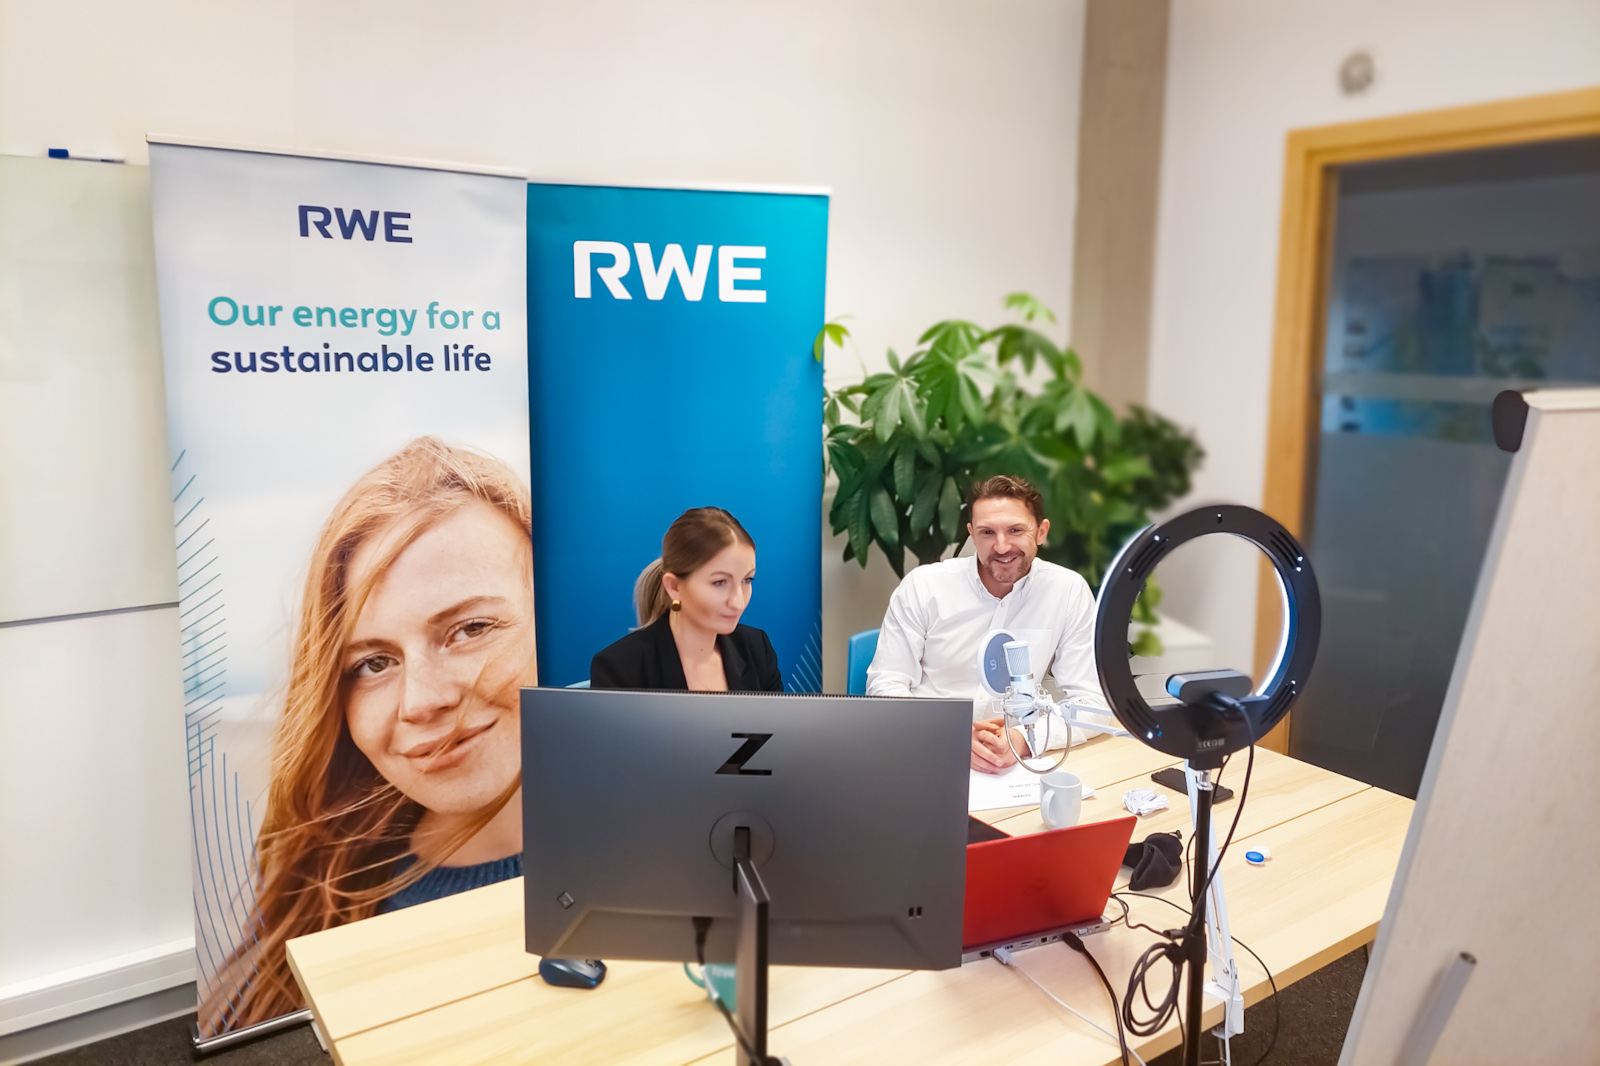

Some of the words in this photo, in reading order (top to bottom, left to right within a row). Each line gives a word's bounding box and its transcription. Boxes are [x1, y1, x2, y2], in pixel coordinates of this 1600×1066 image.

[298, 205, 413, 244] RWE
[573, 240, 767, 303] RWE
[207, 295, 284, 328] Our
[292, 305, 418, 337] energy
[426, 301, 475, 330] for
[482, 311, 501, 331] a
[210, 344, 434, 374] sustainable
[443, 343, 492, 372] life
[715, 732, 773, 776] Z
